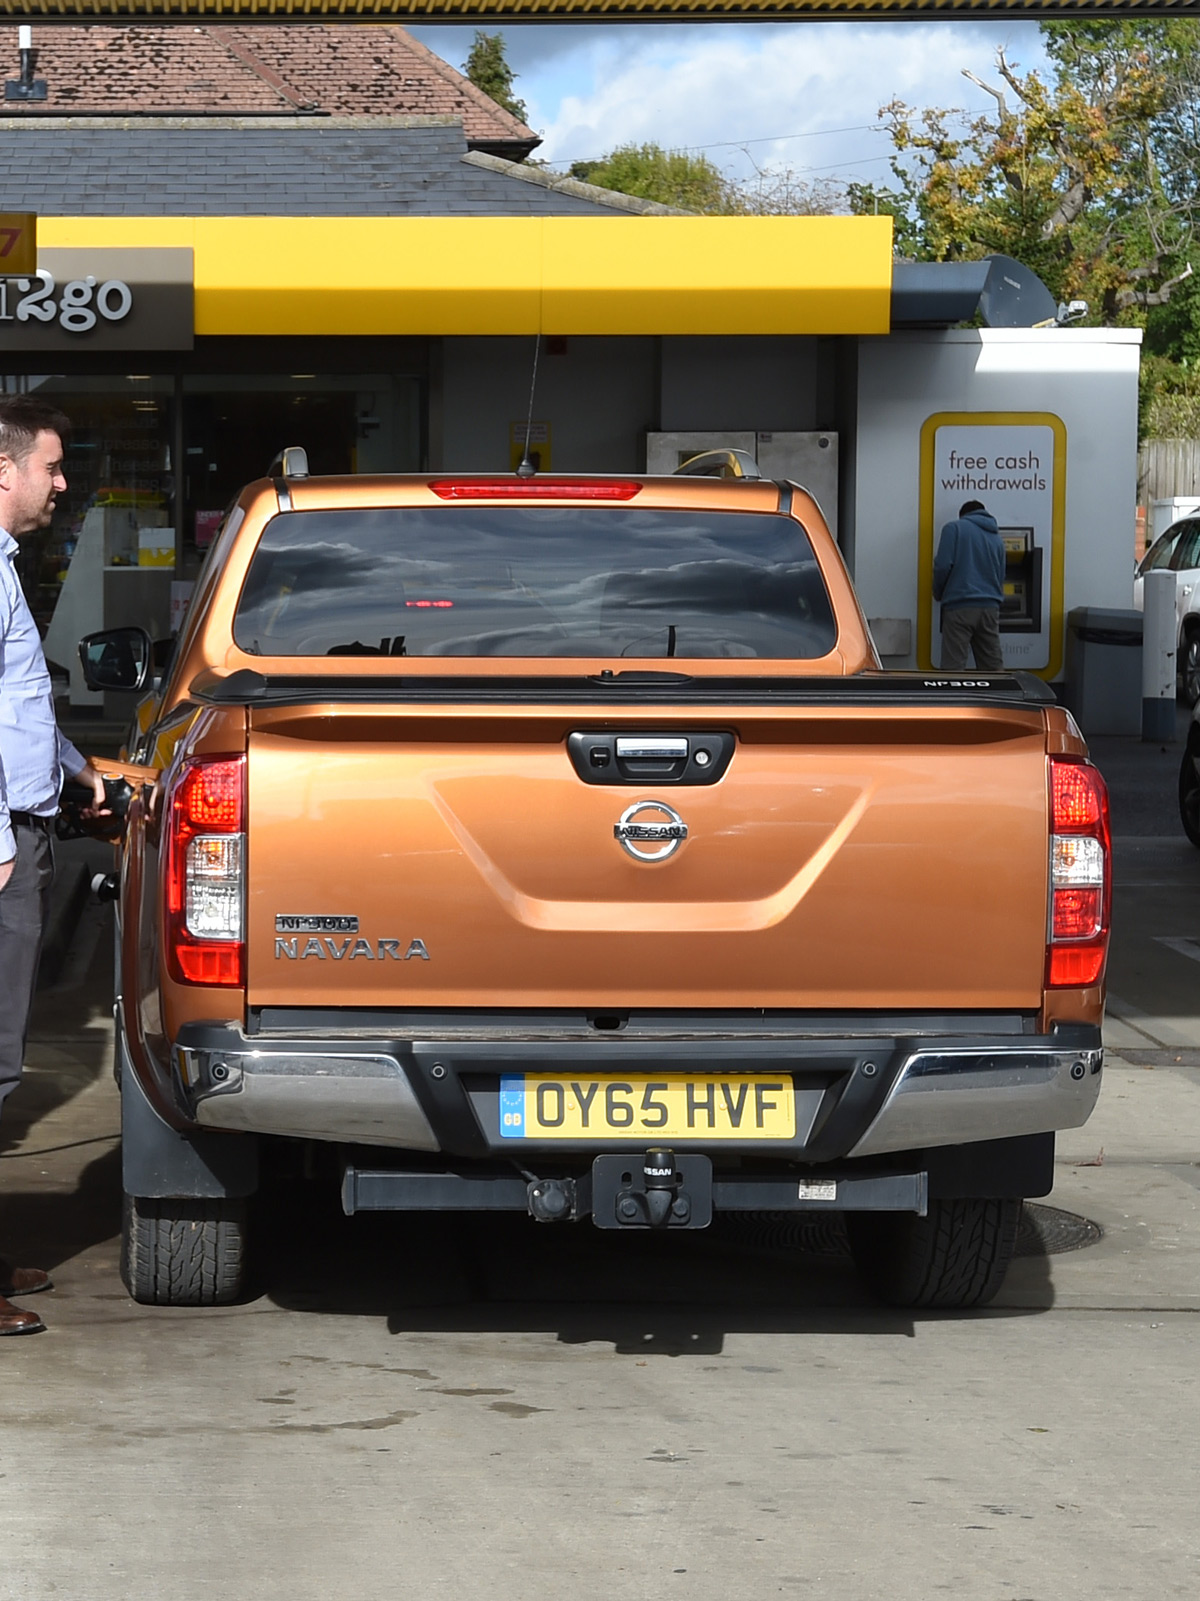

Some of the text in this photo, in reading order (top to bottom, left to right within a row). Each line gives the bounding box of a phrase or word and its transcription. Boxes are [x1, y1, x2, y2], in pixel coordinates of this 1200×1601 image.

[0, 228, 22, 257] 7
[949, 450, 1040, 470] free cash
[941, 473, 1046, 491] withdrawals
[621, 826, 681, 838] NISSAN
[279, 916, 353, 930] NP300
[275, 937, 430, 960] NAVARA
[536, 1082, 668, 1128] OY65
[686, 1082, 783, 1128] HVF
[504, 1112, 521, 1126] GB
